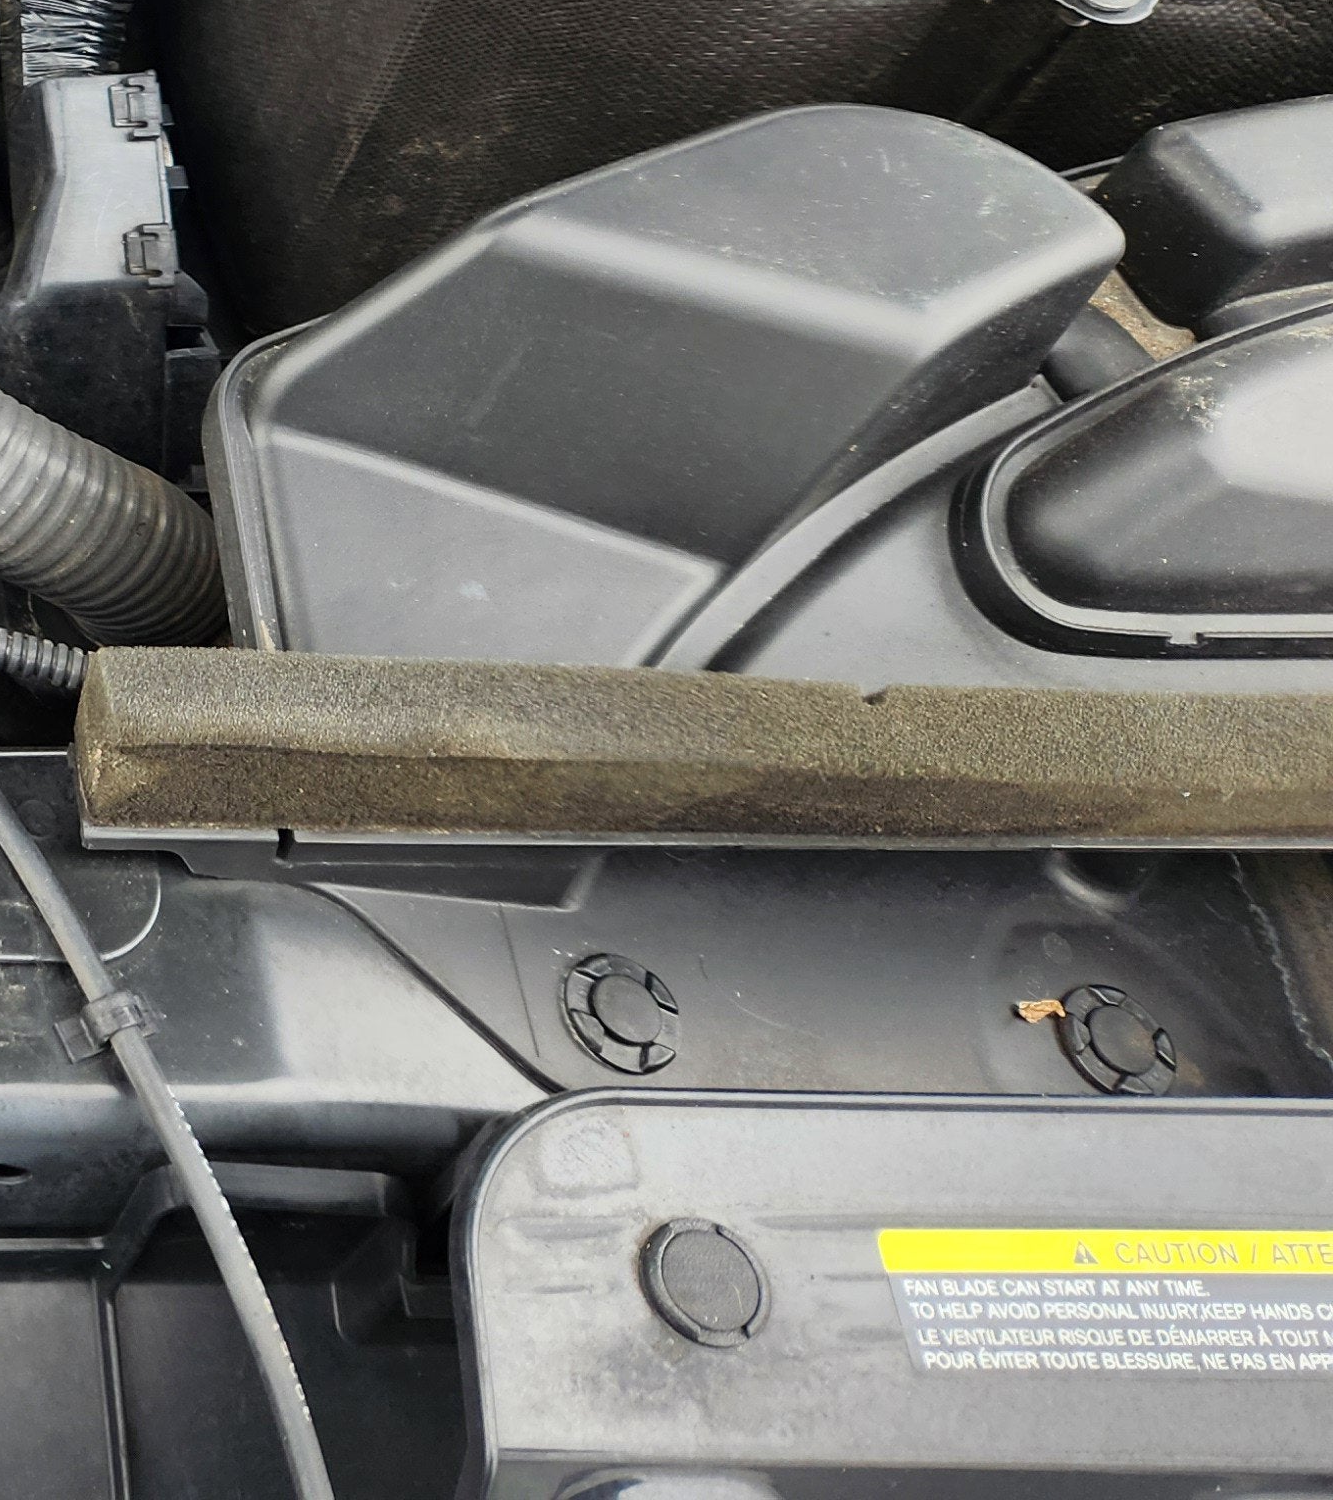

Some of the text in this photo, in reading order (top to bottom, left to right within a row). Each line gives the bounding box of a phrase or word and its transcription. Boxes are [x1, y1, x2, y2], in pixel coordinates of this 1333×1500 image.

[1114, 1241, 1239, 1265] CAUTION
[1272, 1243, 1333, 1265] ATTE
[903, 1278, 1211, 1297] FAN BLADE CAN START AT ANY TIME.
[909, 1302, 935, 1320] TO
[939, 1302, 983, 1320] HELP
[987, 1302, 1041, 1320] AVOID
[1043, 1302, 1139, 1320] PERSONAL
[1250, 1302, 1315, 1320] HANDS
[917, 1329, 941, 1346] LE
[941, 1329, 1057, 1346] VENTILATEUR
[1058, 1329, 1127, 1346] RISQUE
[1128, 1329, 1156, 1346] DE
[1156, 1324, 1257, 1346] DÉMARRER
[1258, 1324, 1272, 1346] À
[1271, 1329, 1320, 1346] TOUT
[924, 1351, 978, 1371] POUR
[979, 1347, 1041, 1371] ÉVITER
[1040, 1352, 1100, 1371] TOUTE
[1101, 1352, 1201, 1371] BLESSURE,
[1202, 1352, 1232, 1371] NE
[1233, 1352, 1268, 1371] PAS
[1270, 1353, 1297, 1371] EN
